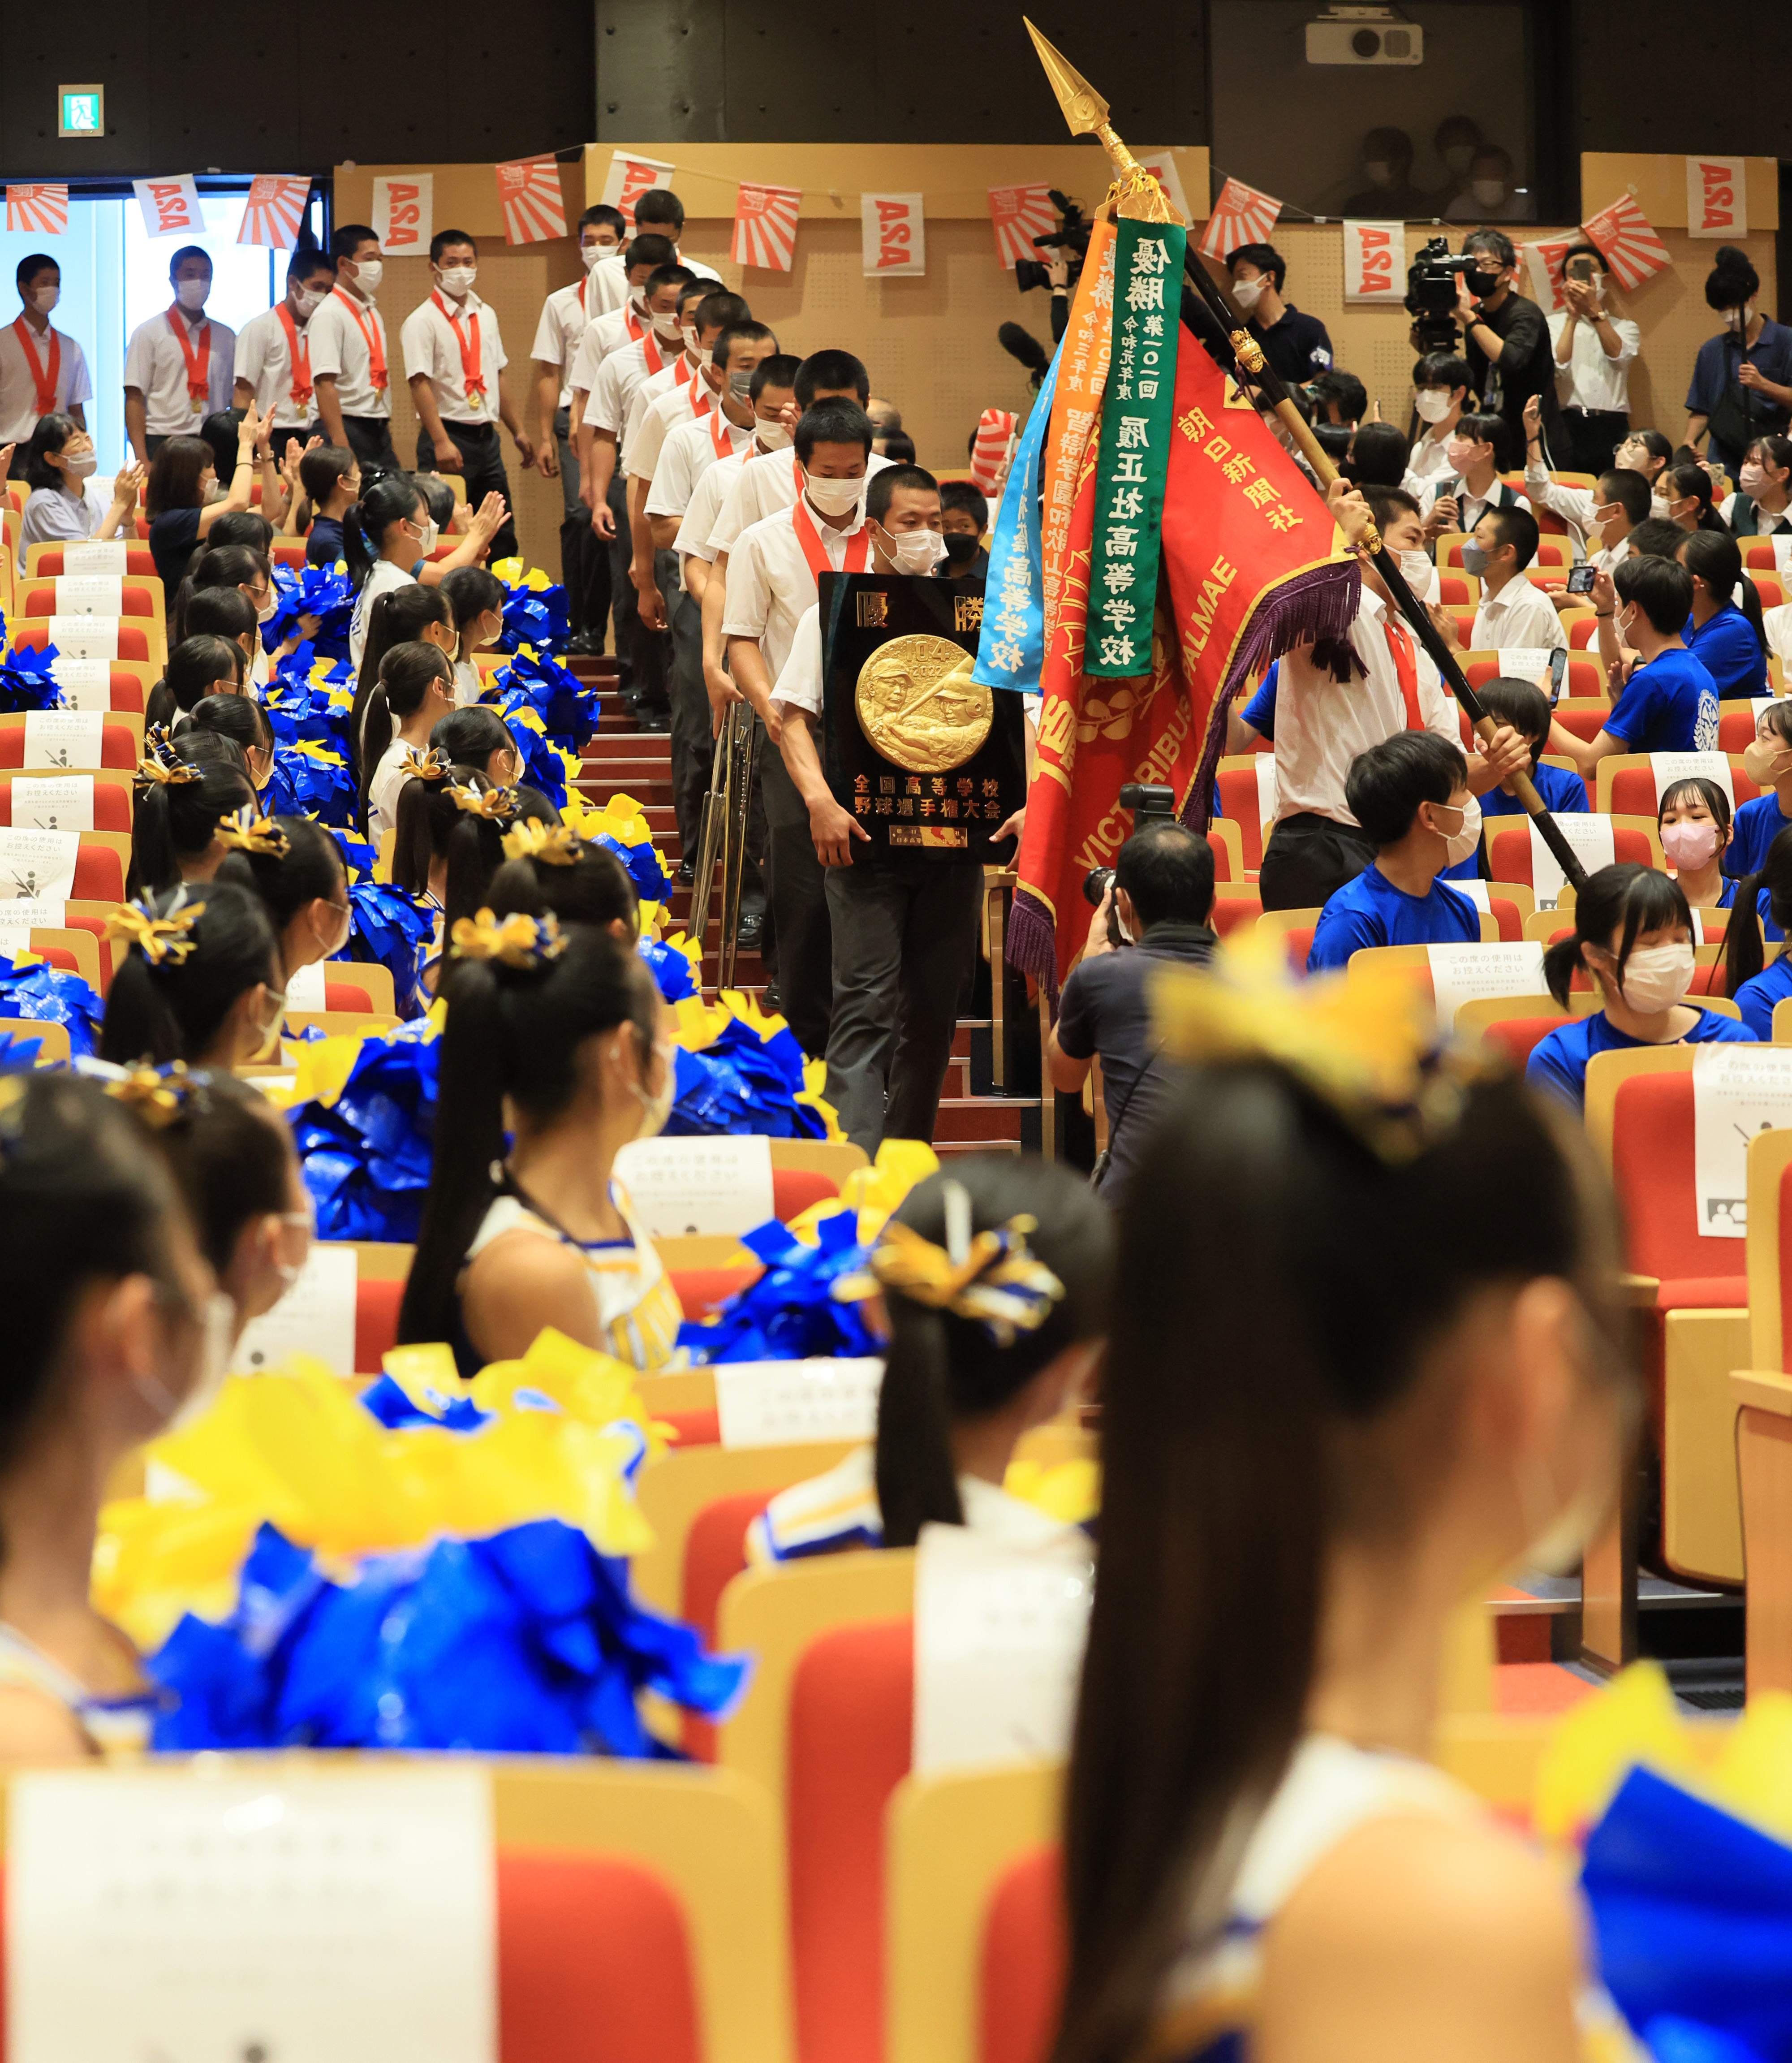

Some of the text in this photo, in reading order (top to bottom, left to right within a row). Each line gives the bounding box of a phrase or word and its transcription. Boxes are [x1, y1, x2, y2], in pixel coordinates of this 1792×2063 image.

[147, 184, 190, 232] ASA
[385, 182, 420, 247] ASA
[1699, 163, 1734, 229] ASA
[875, 200, 911, 268] ASA
[1358, 227, 1392, 293] ASA
[1177, 406, 1304, 532] 朝日新聞社
[906, 640, 950, 662] 104
[912, 665, 943, 677] 2022
[1073, 694, 1193, 872] VICTRIBUS
